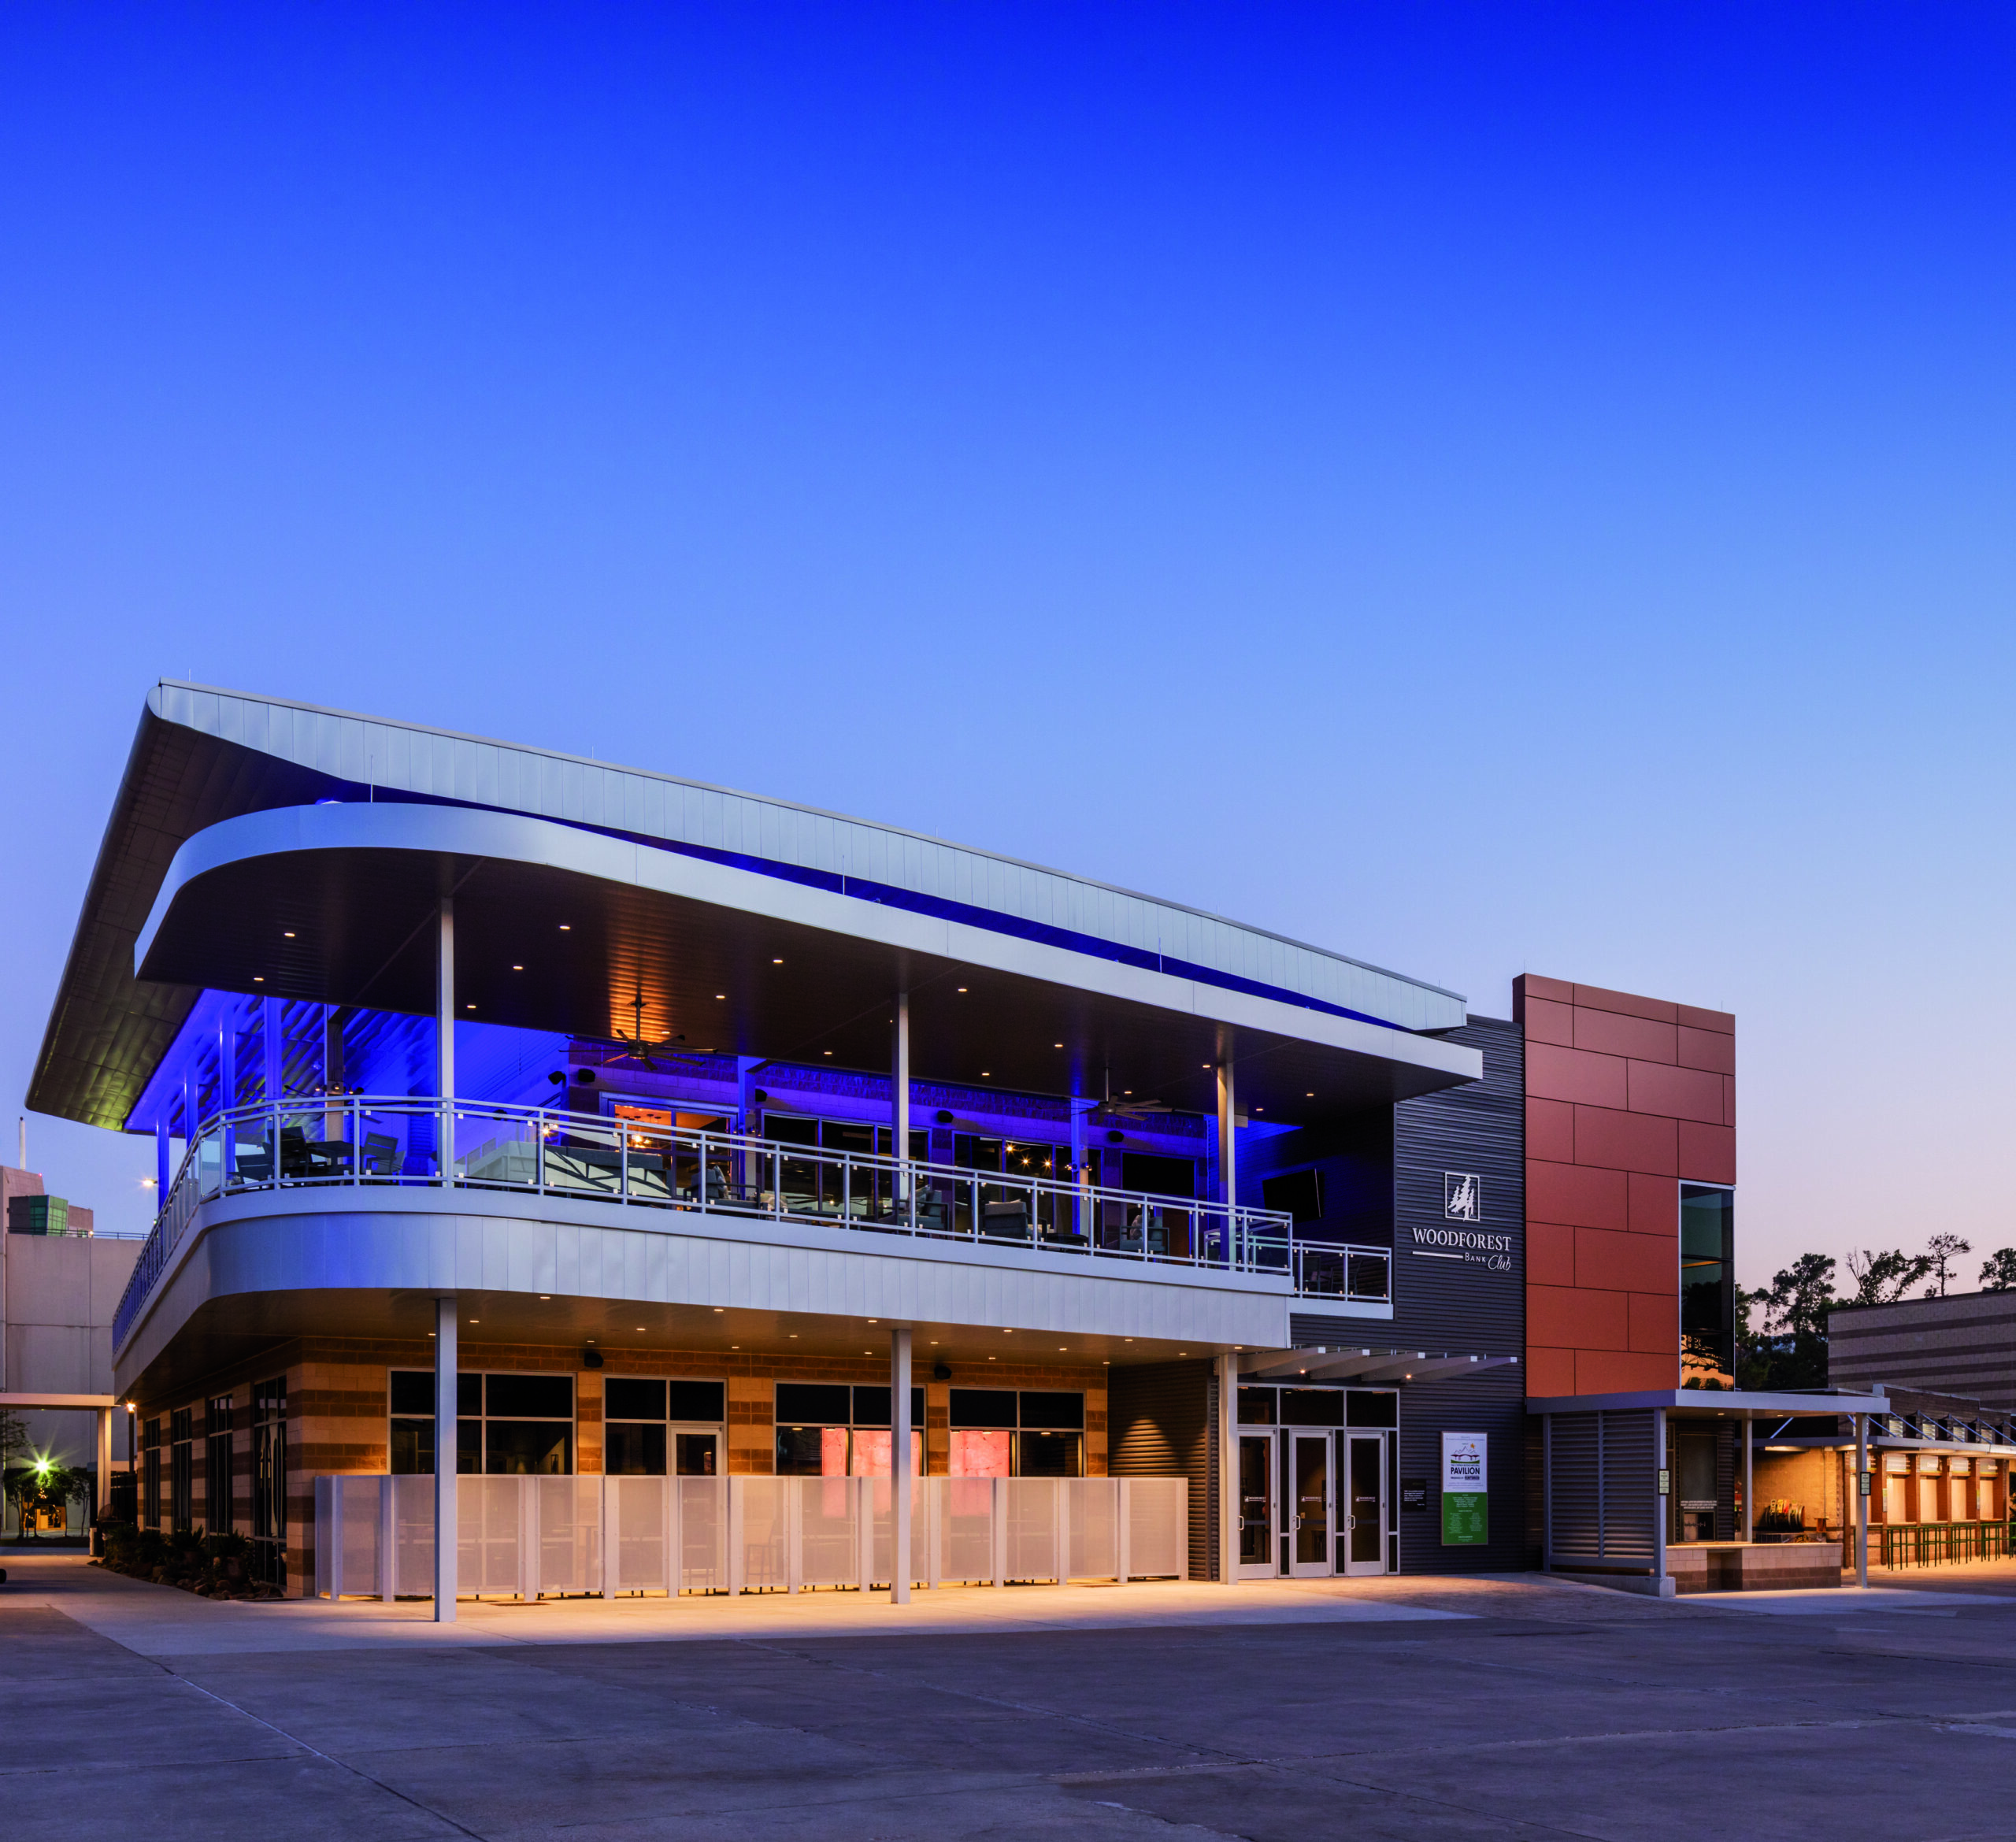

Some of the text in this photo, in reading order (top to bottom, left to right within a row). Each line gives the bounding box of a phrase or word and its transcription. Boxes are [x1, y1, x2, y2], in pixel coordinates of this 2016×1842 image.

[1412, 1228, 1511, 1251] WOODFOREST
[1465, 1252, 1511, 1271] BANK Club
